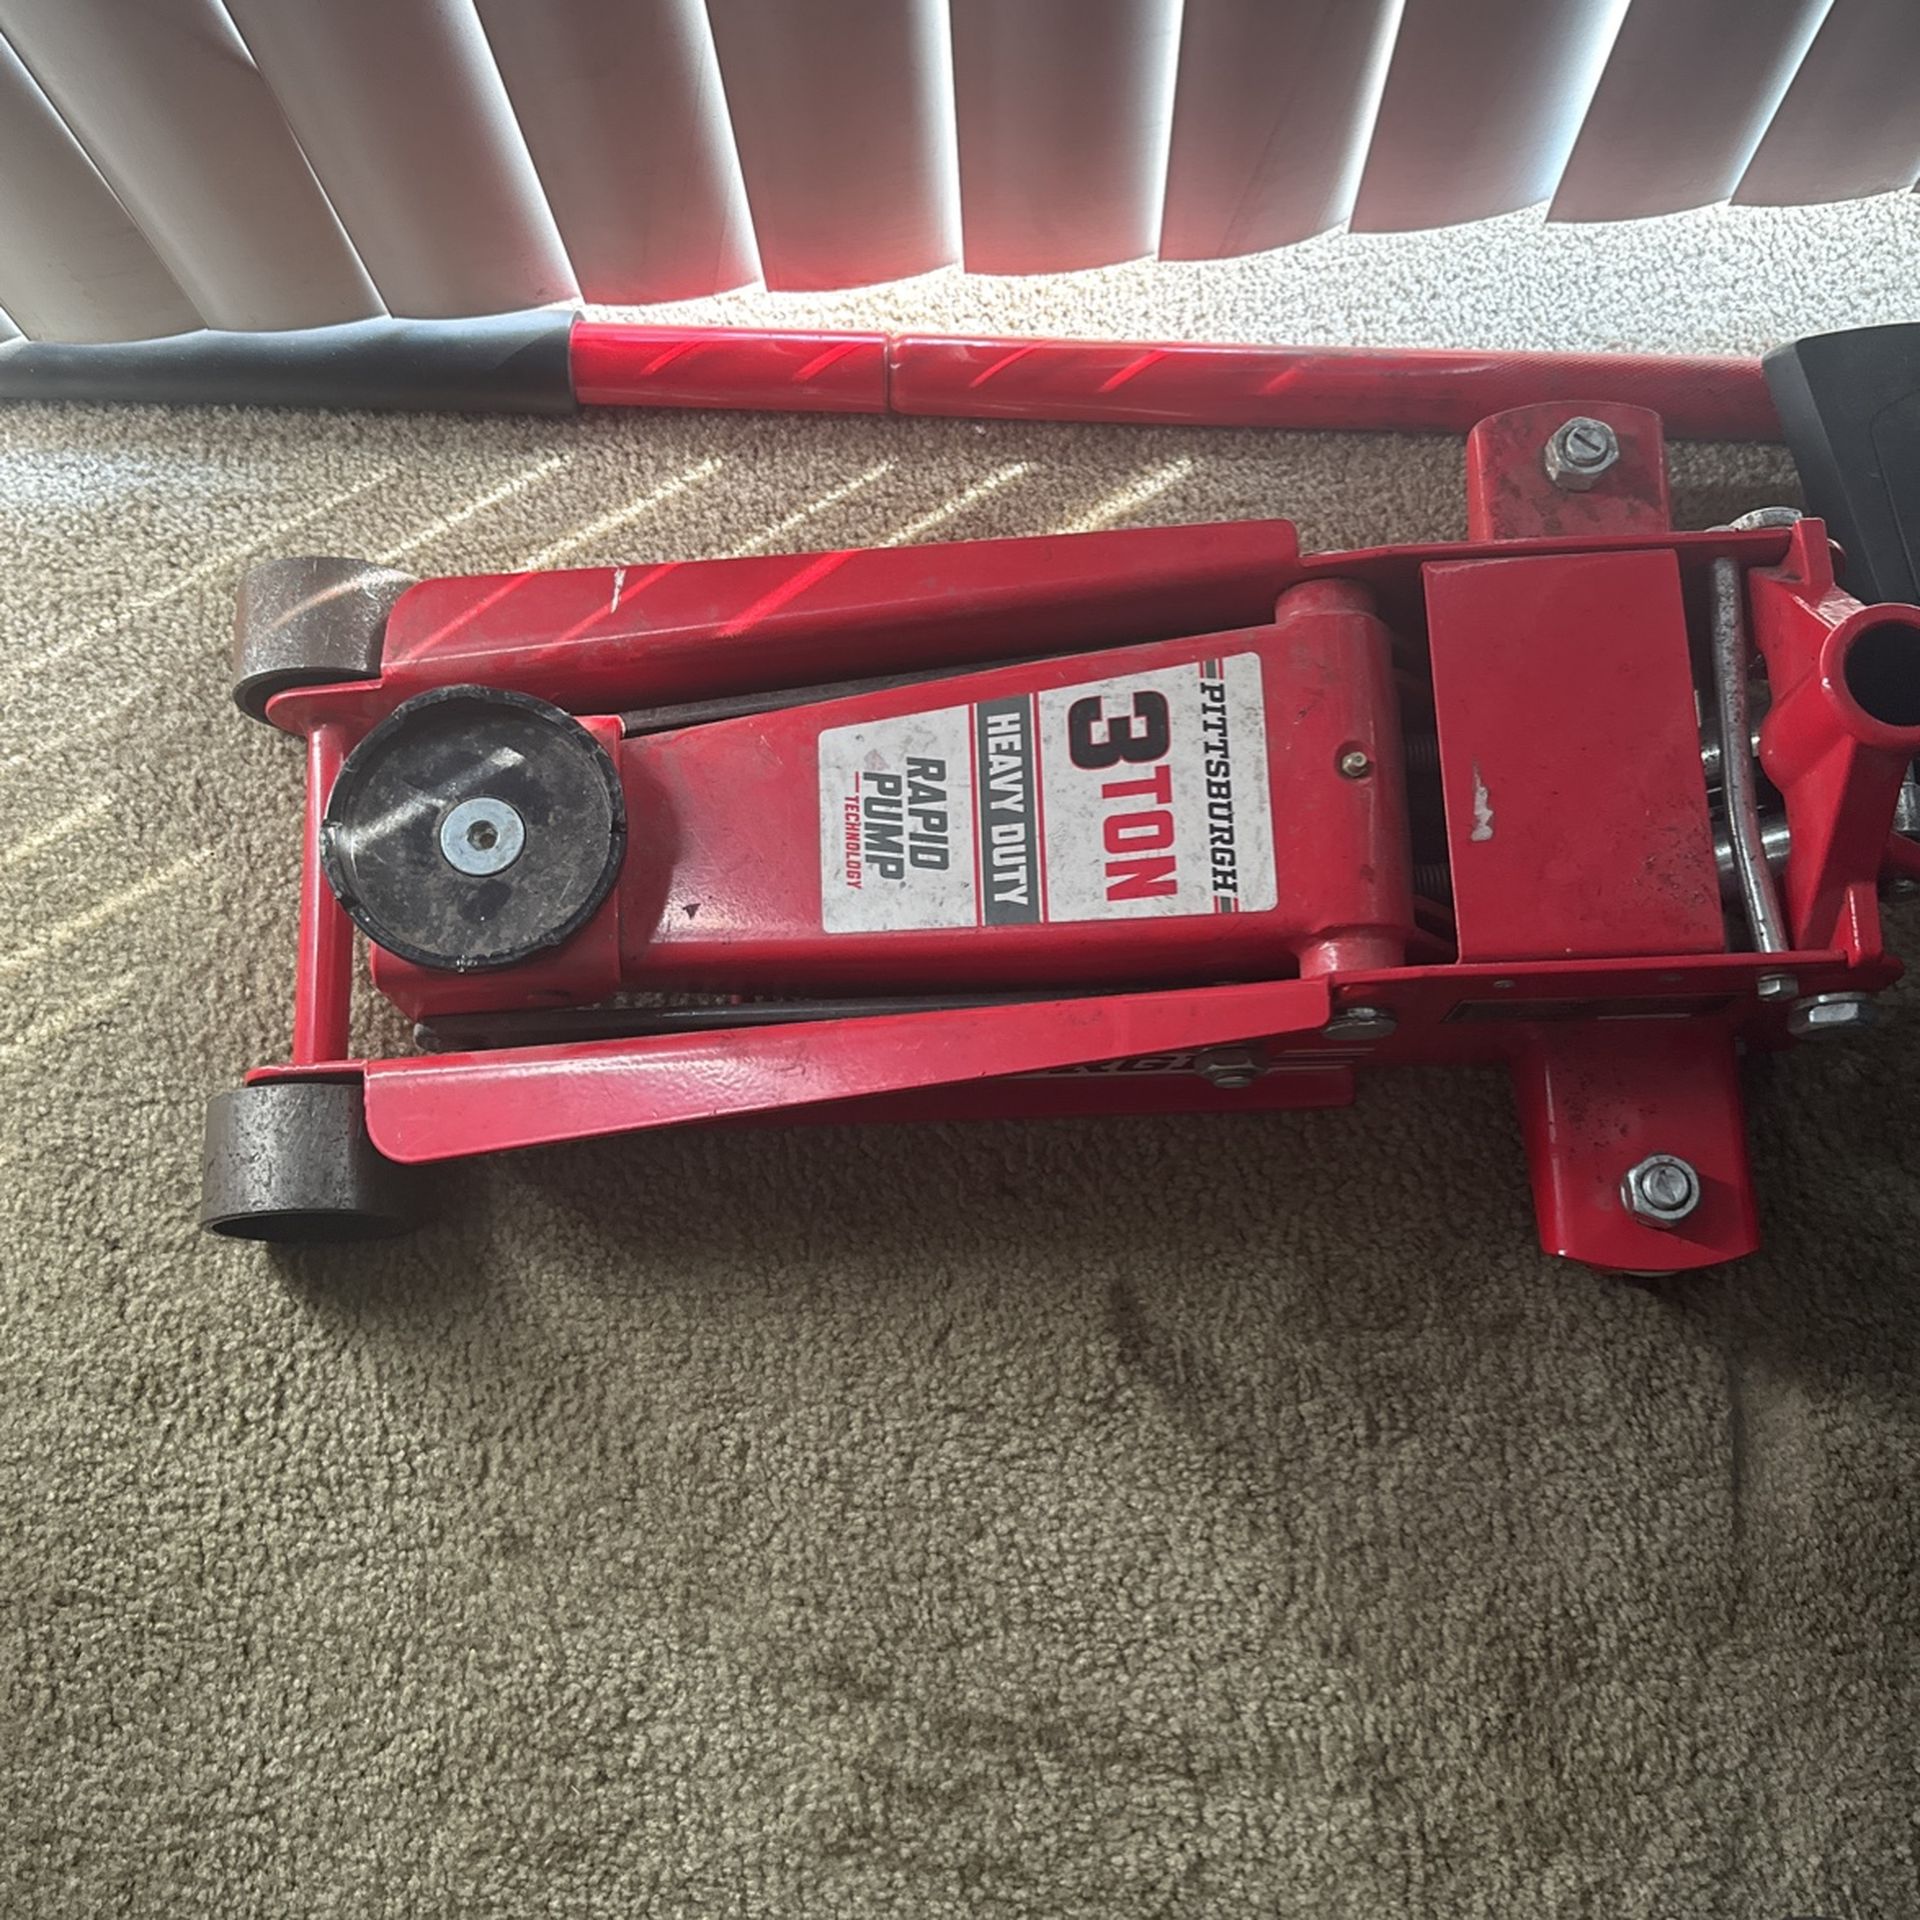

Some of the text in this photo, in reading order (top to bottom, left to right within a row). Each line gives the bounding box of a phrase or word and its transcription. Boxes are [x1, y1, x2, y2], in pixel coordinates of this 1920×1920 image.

[844, 795, 862, 890] TECHNOLOGY
[863, 772, 905, 880] PUMP
[906, 756, 950, 871] RAPID
[986, 712, 1029, 905] HEAVY DUTY
[1200, 682, 1238, 898] PITTSBURGH
